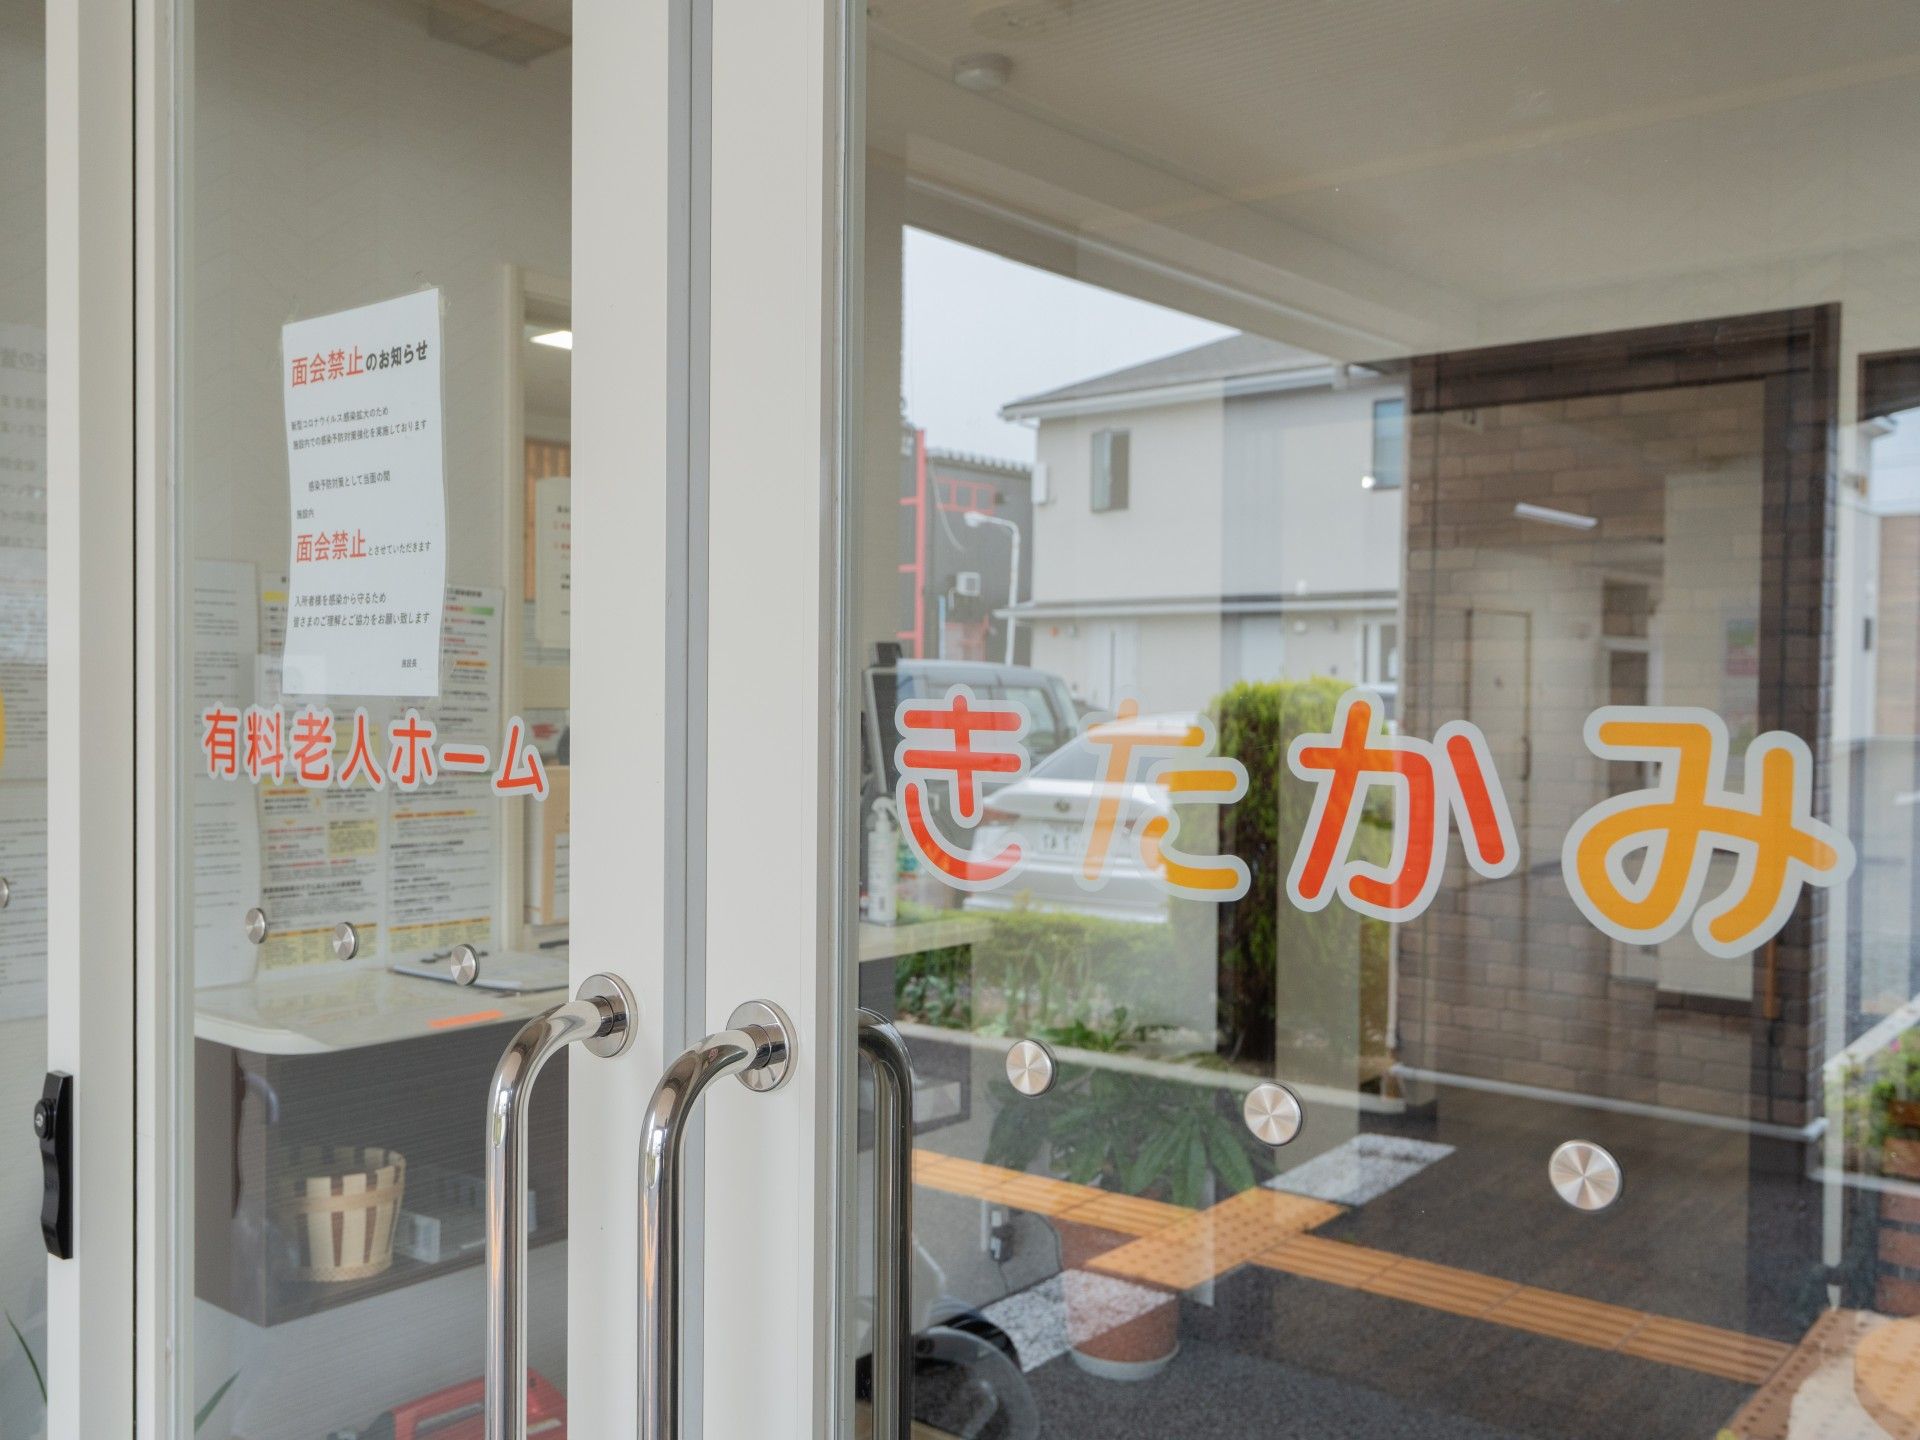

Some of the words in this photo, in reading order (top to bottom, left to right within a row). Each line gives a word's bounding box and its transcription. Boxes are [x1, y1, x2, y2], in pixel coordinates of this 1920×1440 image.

[291, 339, 428, 388] 面会禁止のお知らせ
[290, 406, 389, 430] 新型コロナウイルス感染拡大のため
[292, 419, 427, 451] 施設内での感染予防対策強化を実施しております
[308, 470, 391, 492] 感染予防対策として当面の間
[296, 529, 431, 564] 面会禁止とさせていただきます
[294, 591, 387, 606] 入所者様を感染から守るため
[293, 612, 431, 628] 皆さまのご理解とご協力をお願い致します
[202, 706, 545, 796] 有料老人ホーム
[902, 690, 1840, 946] きたかみ
